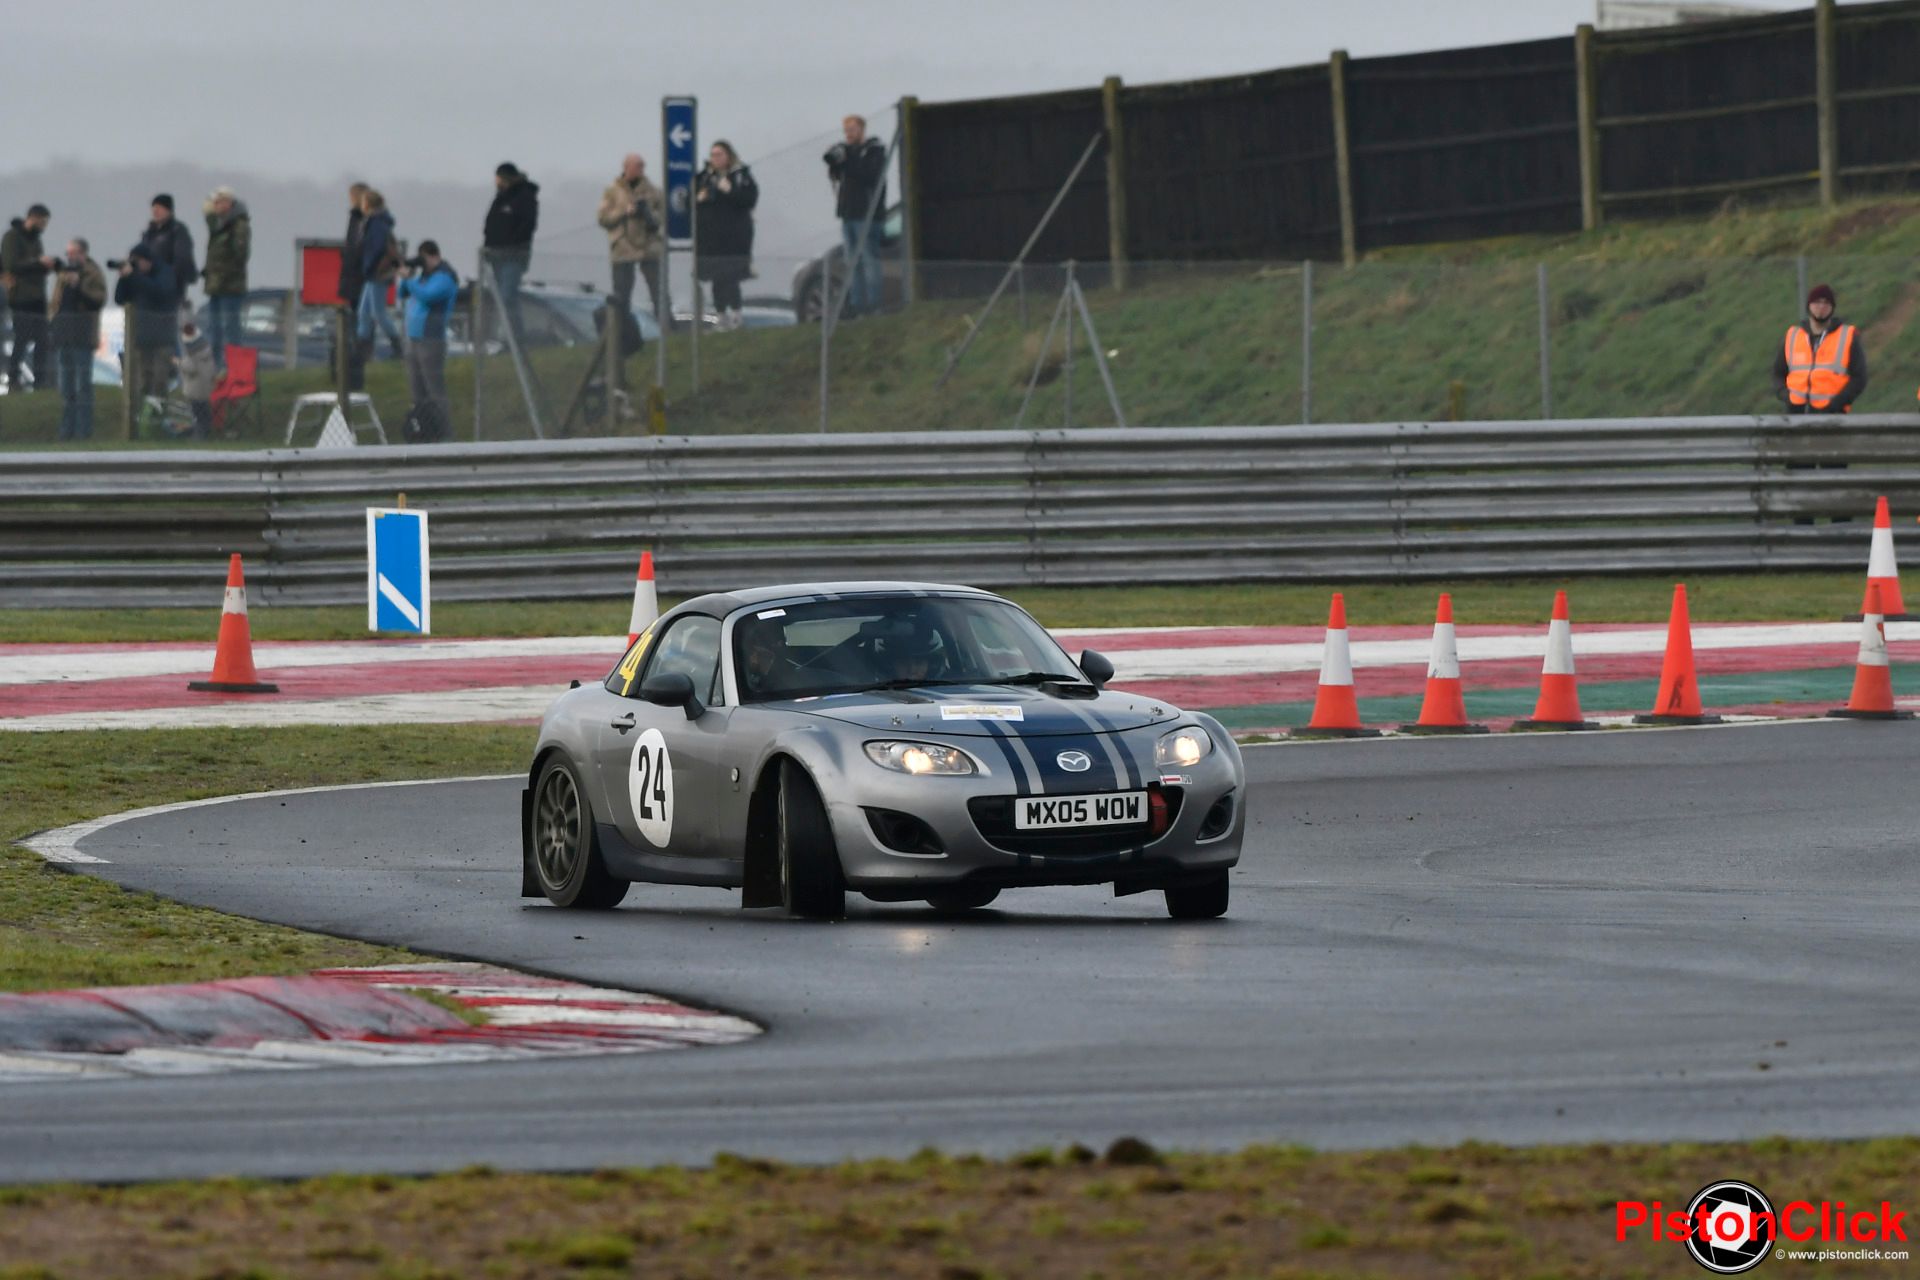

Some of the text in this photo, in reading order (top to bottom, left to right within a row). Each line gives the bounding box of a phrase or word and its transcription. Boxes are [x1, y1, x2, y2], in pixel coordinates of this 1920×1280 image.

[638, 744, 666, 822] 24
[1026, 796, 1140, 825] MX05 WOW
